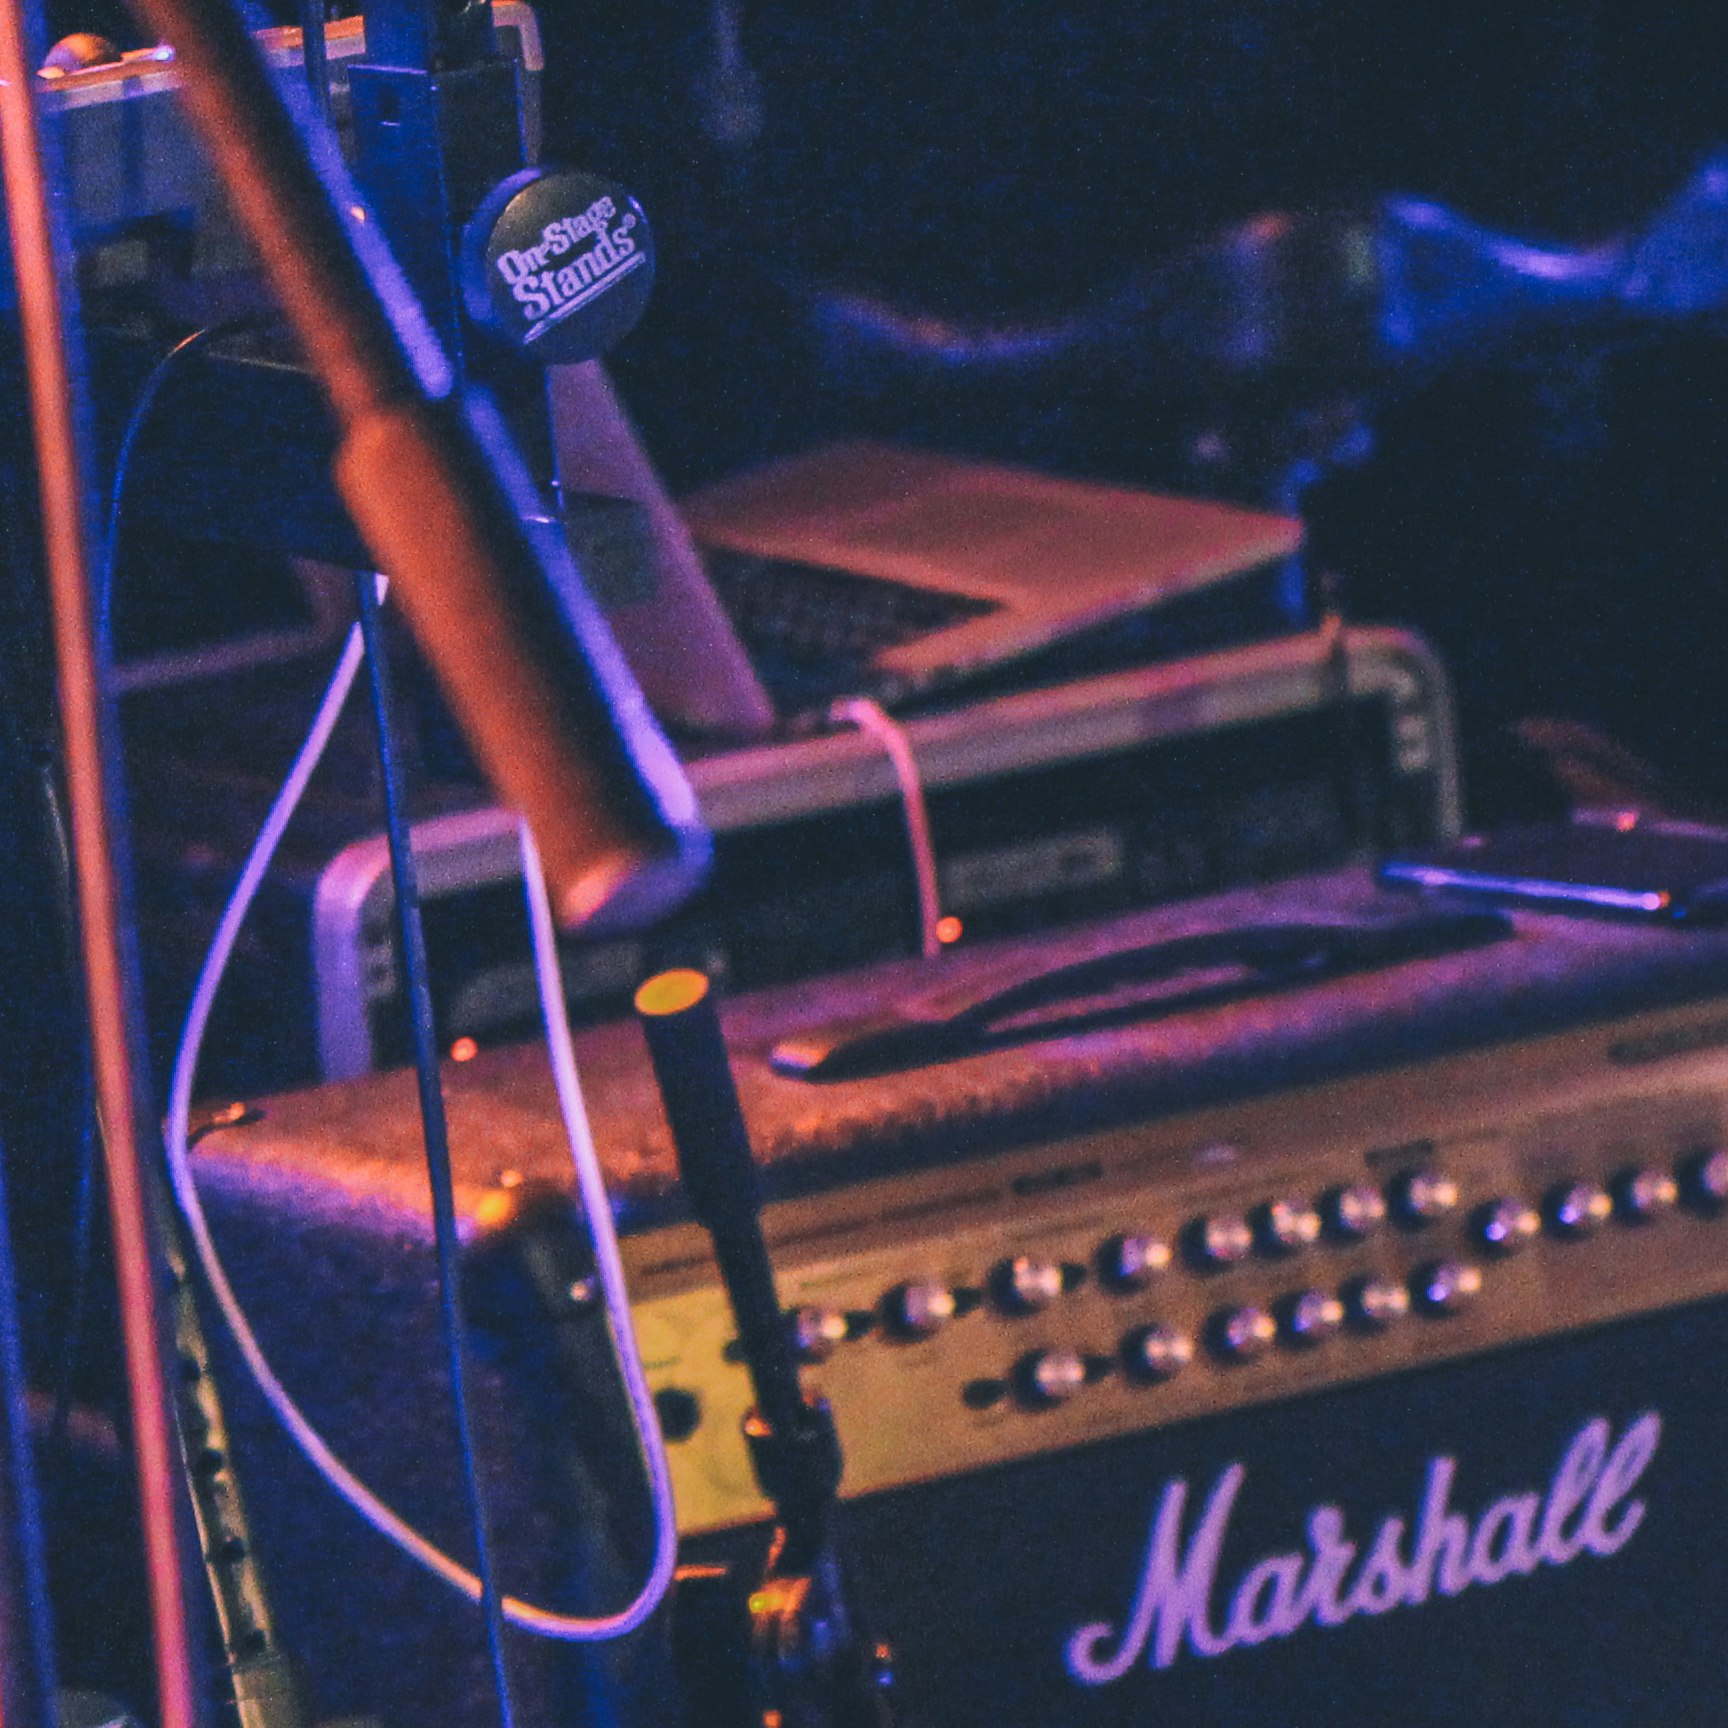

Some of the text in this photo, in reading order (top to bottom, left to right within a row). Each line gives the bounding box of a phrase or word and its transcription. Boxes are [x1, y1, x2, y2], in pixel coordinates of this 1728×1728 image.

[495, 195, 617, 285] On-Stage
[512, 226, 636, 320] Stands
[1062, 1410, 1662, 1686] Marshall
